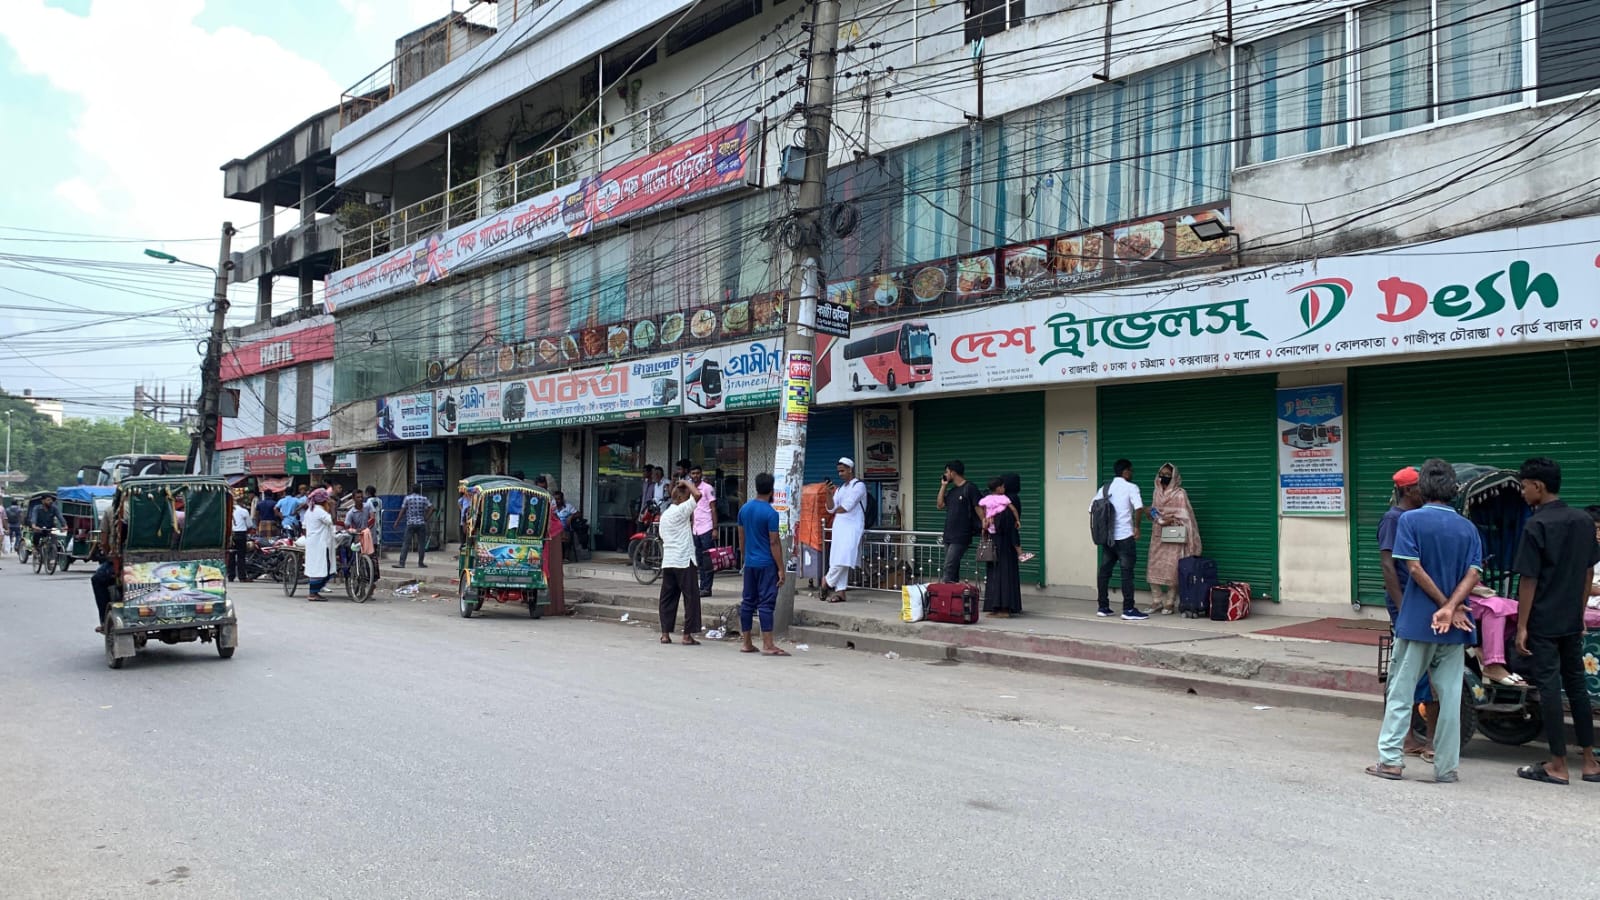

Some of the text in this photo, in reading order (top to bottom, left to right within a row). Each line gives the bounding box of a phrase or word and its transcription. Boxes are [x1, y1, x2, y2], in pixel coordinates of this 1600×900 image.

[642, 160, 668, 195] গার্ডেন
[456, 231, 477, 257] শেফ
[480, 217, 509, 249] গার্ডেন
[1376, 260, 1559, 323] Desh
[817, 303, 850, 323] কাজী অফিস
[724, 343, 782, 377] গ্রামীণ
[951, 326, 1036, 364] দেশ
[1068, 318, 1583, 375] রাজশাহী ঢাকা চট্টগ্রাম কক্সবাজার যশোর বেনাপোল কোলকাতা গাজীপুর চৌরাস্তা বোর্ড বাজার
[527, 366, 629, 404] একতা
[555, 414, 605, 425] 01407-022026
